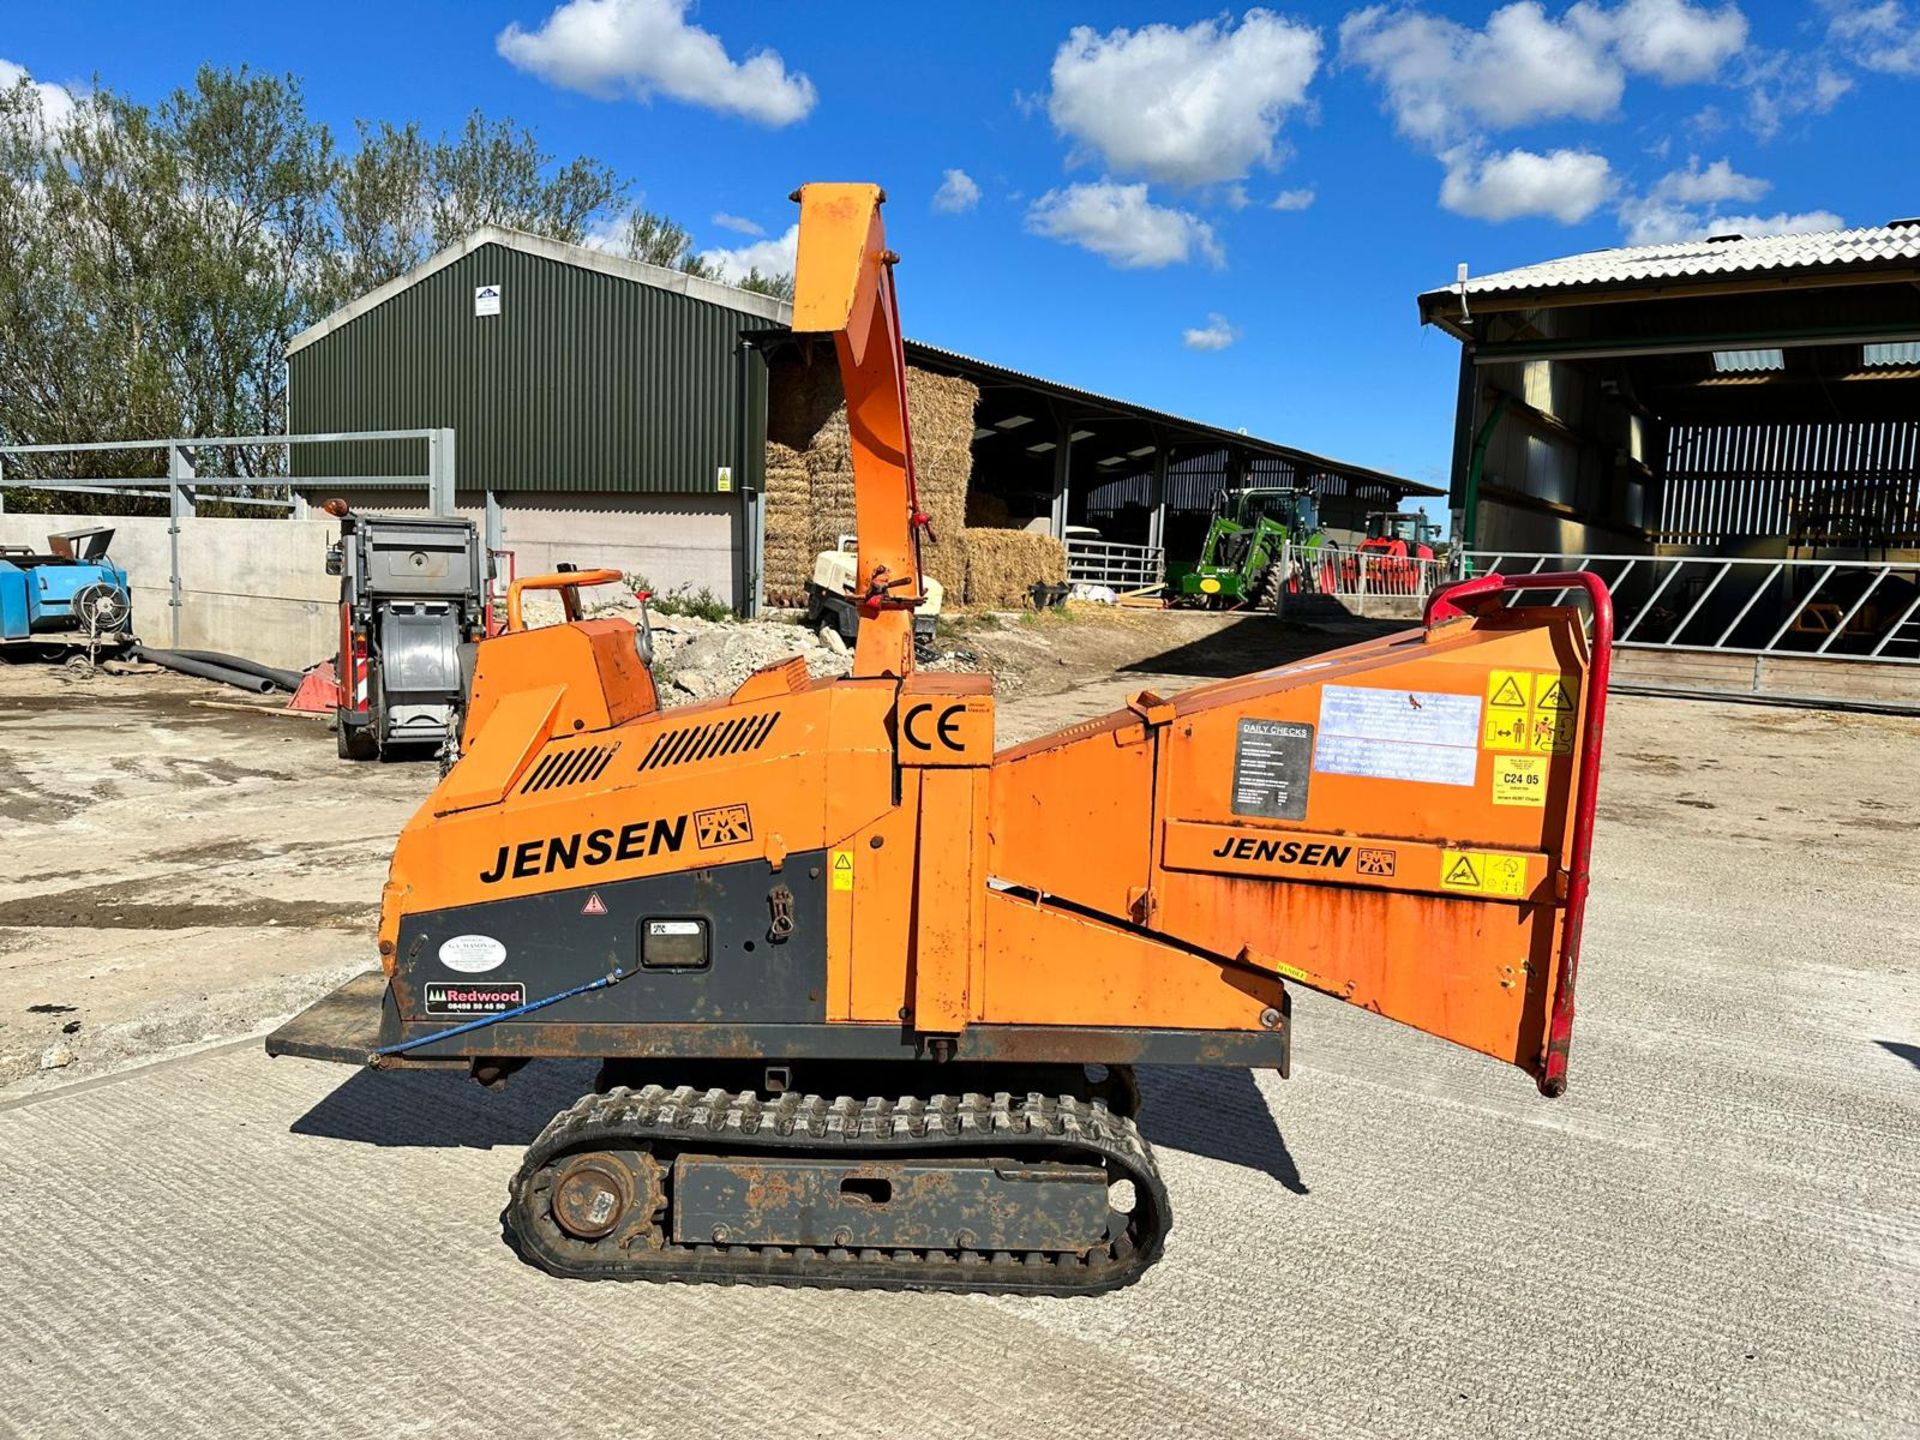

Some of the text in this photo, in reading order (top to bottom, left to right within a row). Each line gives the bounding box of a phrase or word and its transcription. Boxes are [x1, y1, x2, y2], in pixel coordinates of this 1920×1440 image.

[904, 703, 966, 751] CE
[1243, 724, 1307, 738] DAILY CHECKS
[1504, 773, 1539, 785] C24 05
[480, 815, 688, 884] JENSEN
[1213, 837, 1352, 868] JENSEN
[447, 990, 519, 1002] Redwood
